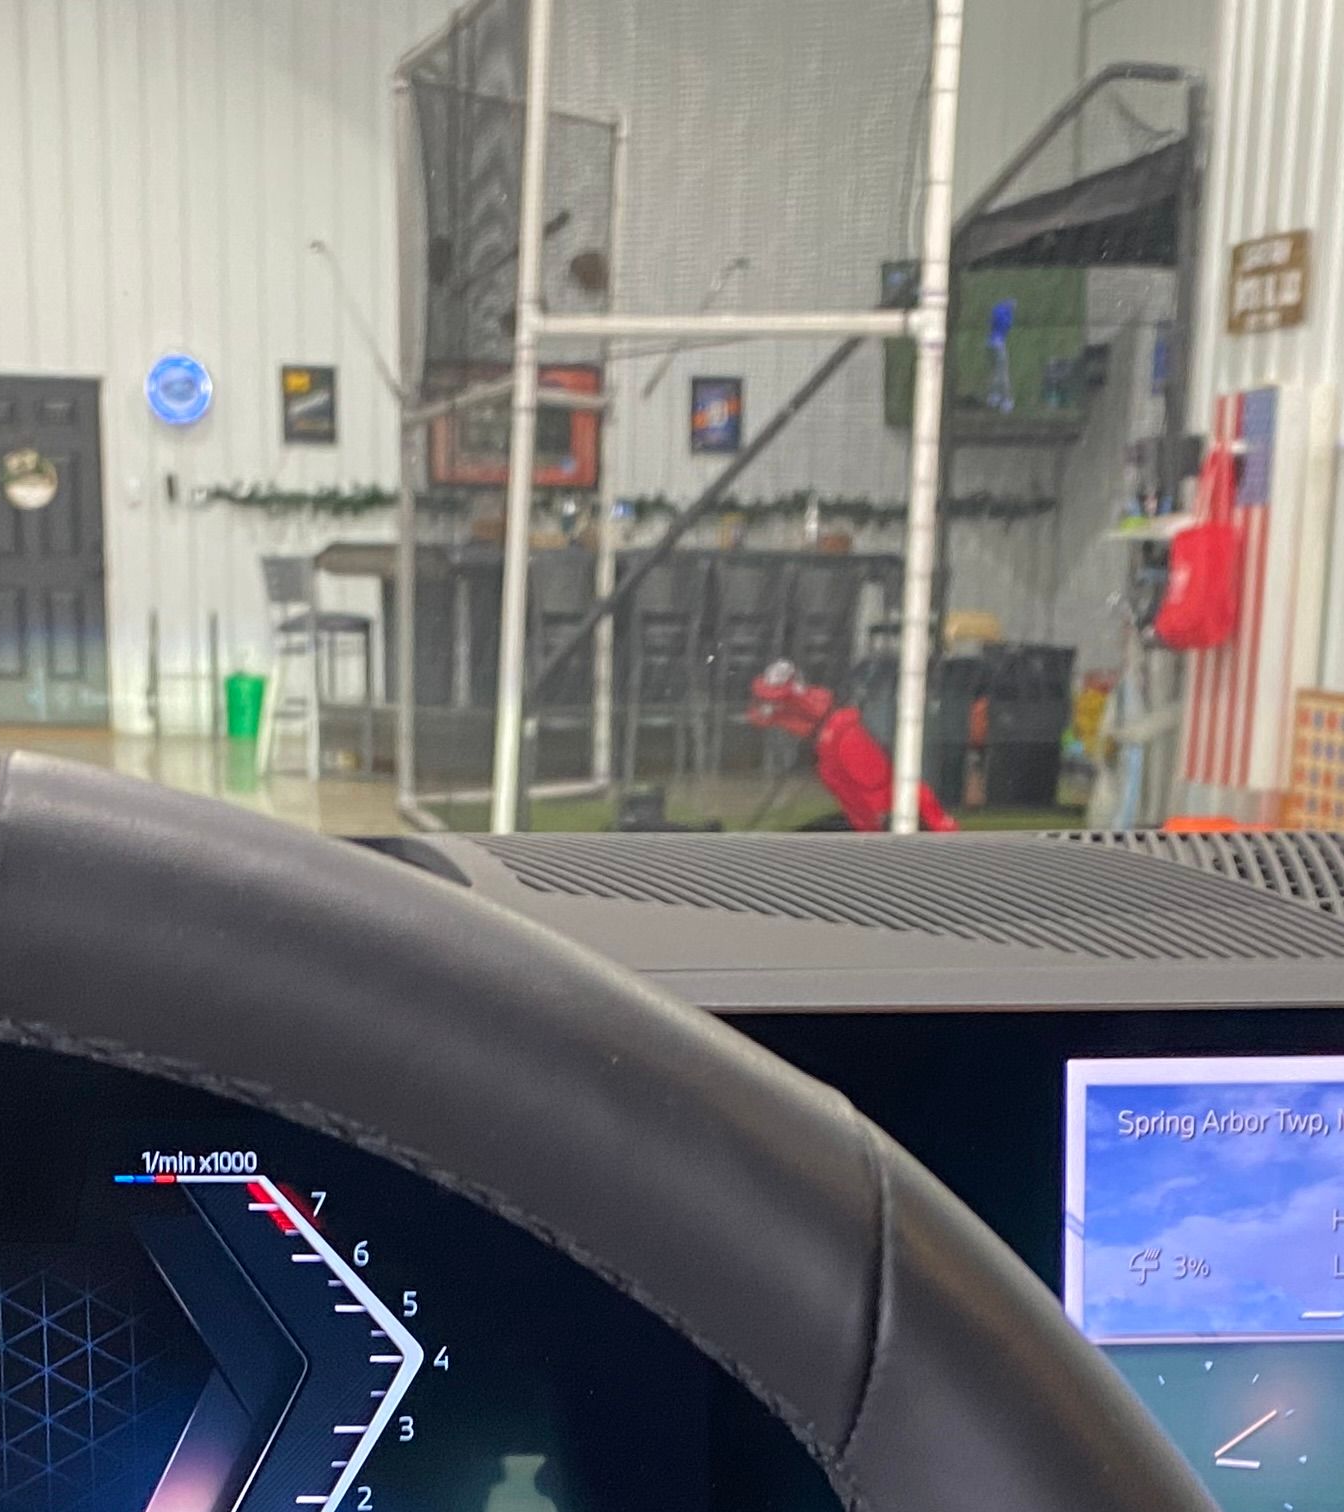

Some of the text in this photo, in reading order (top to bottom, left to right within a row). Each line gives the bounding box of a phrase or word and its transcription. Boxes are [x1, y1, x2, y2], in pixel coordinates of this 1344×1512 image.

[1118, 1109, 1196, 1139] Spring
[1202, 1106, 1269, 1133] Arbor
[1276, 1106, 1330, 1136] Twp,
[141, 1151, 257, 1174] 1/min x1000
[311, 1191, 327, 1217] 7
[353, 1240, 369, 1267] 6
[1173, 1256, 1211, 1278] 3%
[402, 1291, 418, 1318] 5
[433, 1346, 450, 1371] 4
[399, 1416, 414, 1442] 3
[356, 1487, 373, 1511] 2
